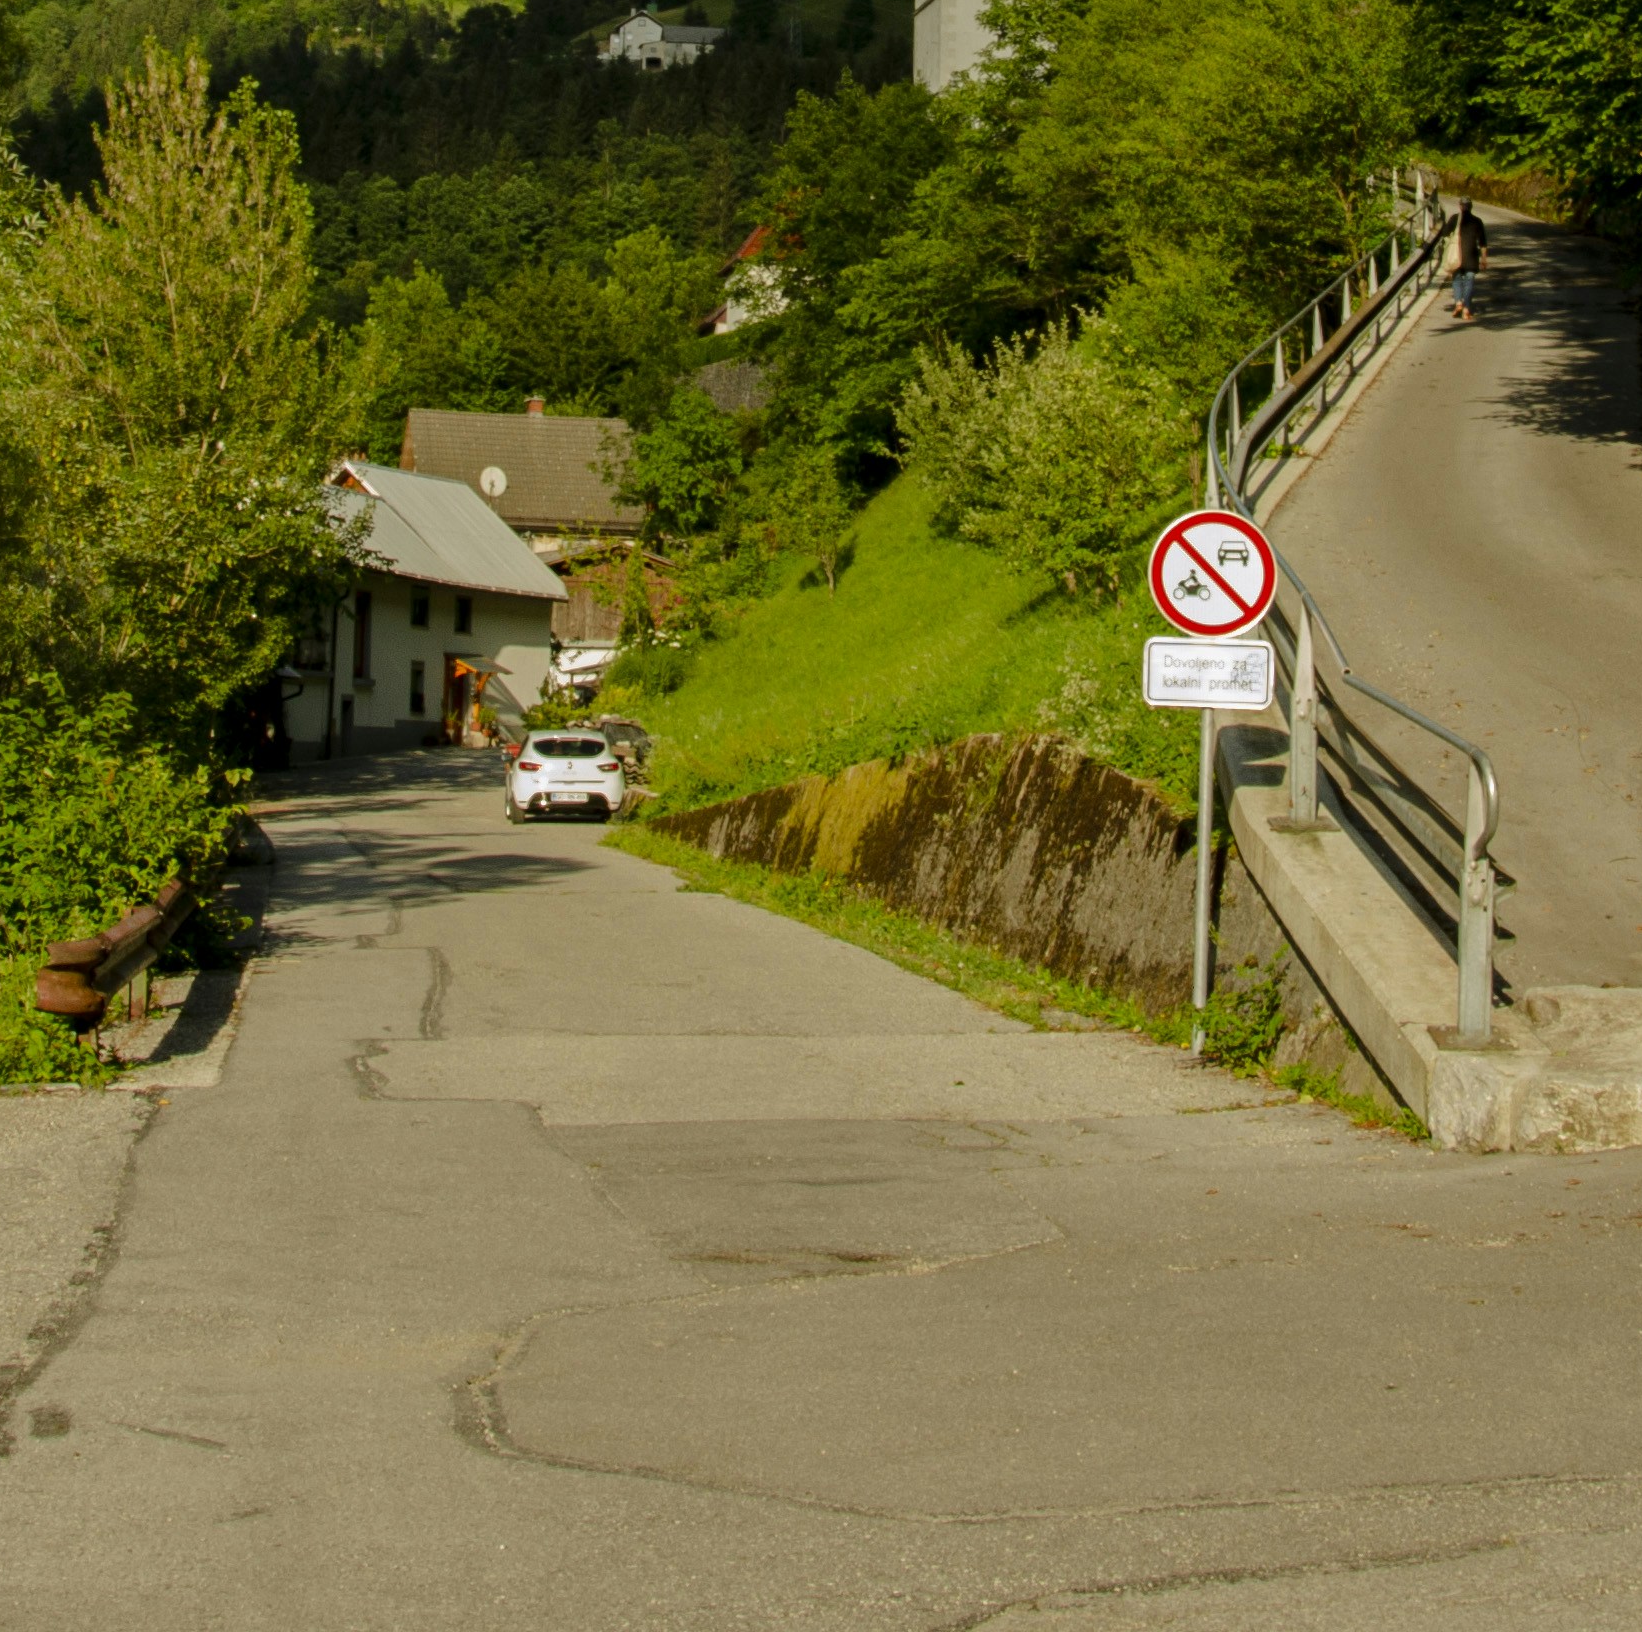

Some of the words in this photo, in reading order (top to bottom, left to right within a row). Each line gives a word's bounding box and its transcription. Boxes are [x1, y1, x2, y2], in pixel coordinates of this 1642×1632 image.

[1164, 655, 1225, 671] Dovoljeno
[1232, 659, 1248, 670] za
[1163, 675, 1201, 688] lokalni
[1209, 679, 1253, 692] promet
